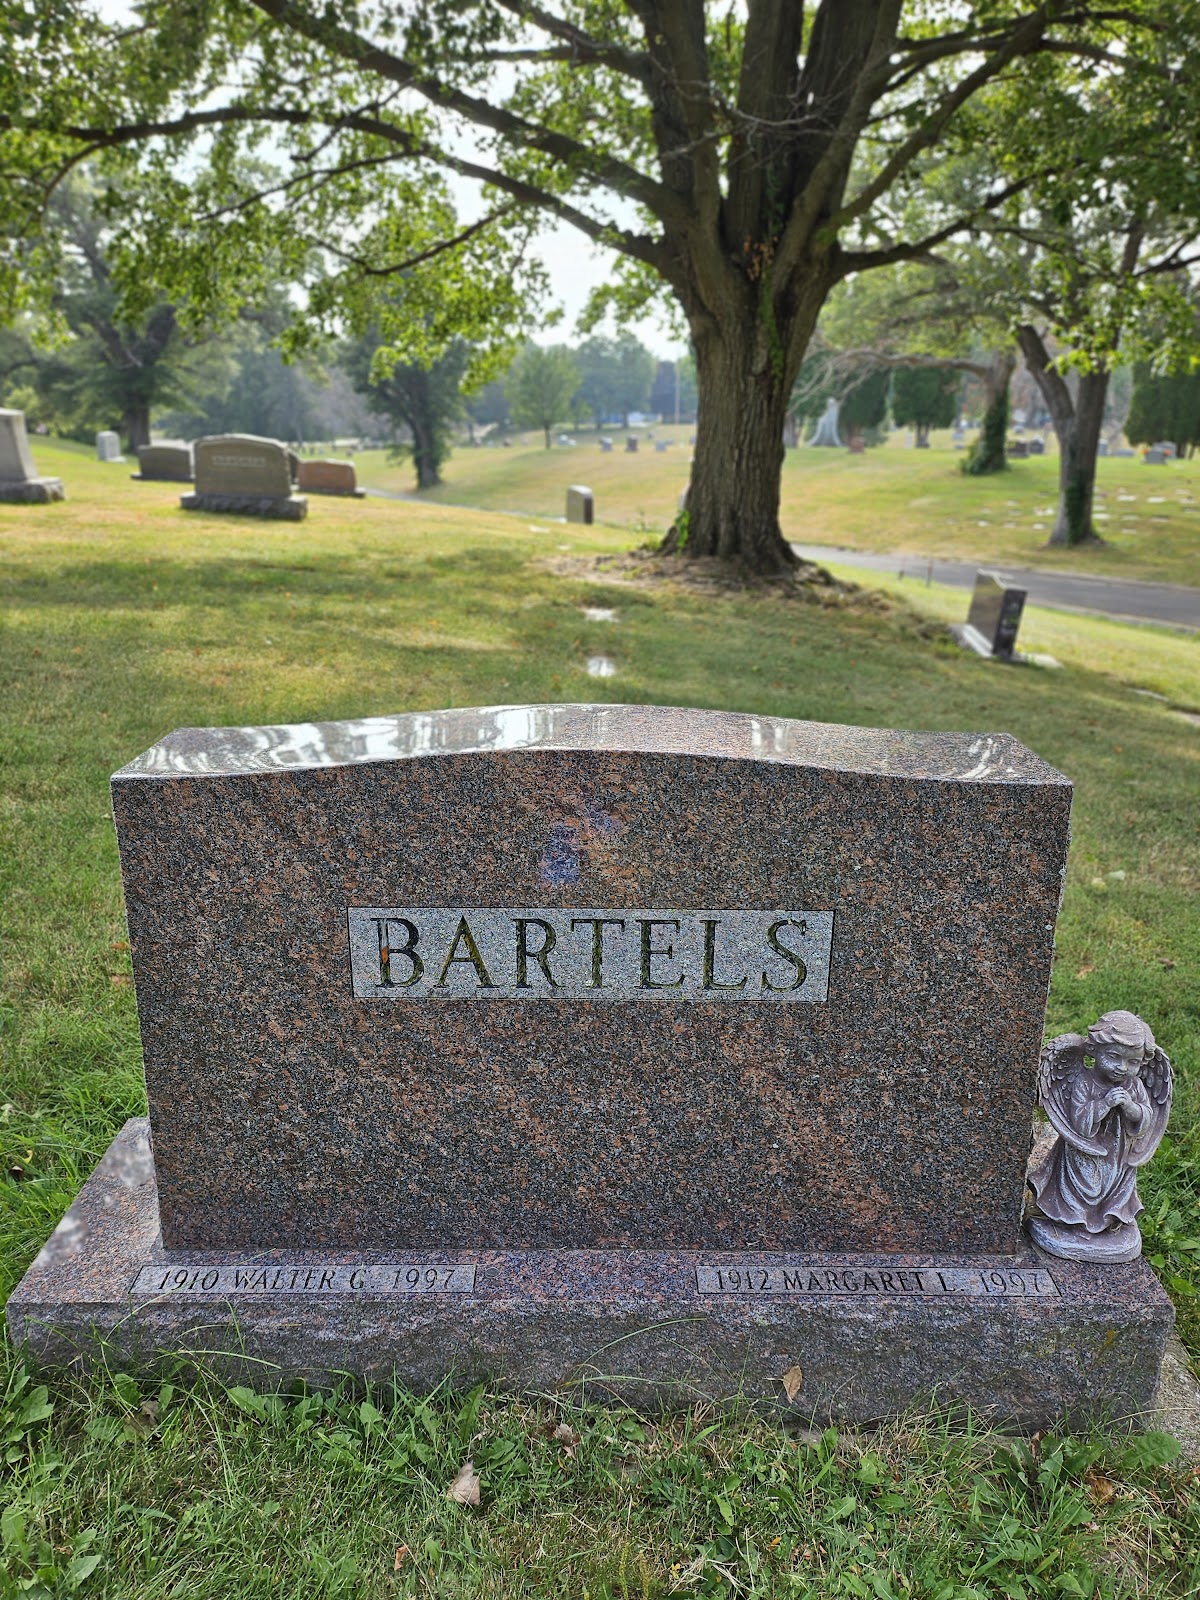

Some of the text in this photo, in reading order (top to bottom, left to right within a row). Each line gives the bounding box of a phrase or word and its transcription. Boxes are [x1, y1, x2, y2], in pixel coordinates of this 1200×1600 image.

[370, 915, 807, 993] BARTELS
[157, 1268, 220, 1291] 1910
[233, 1269, 336, 1291] WALTER
[392, 1267, 456, 1291] 1997
[716, 1268, 773, 1291] 1912
[782, 1269, 925, 1293] MARGARET
[979, 1271, 1043, 1295] 1997
